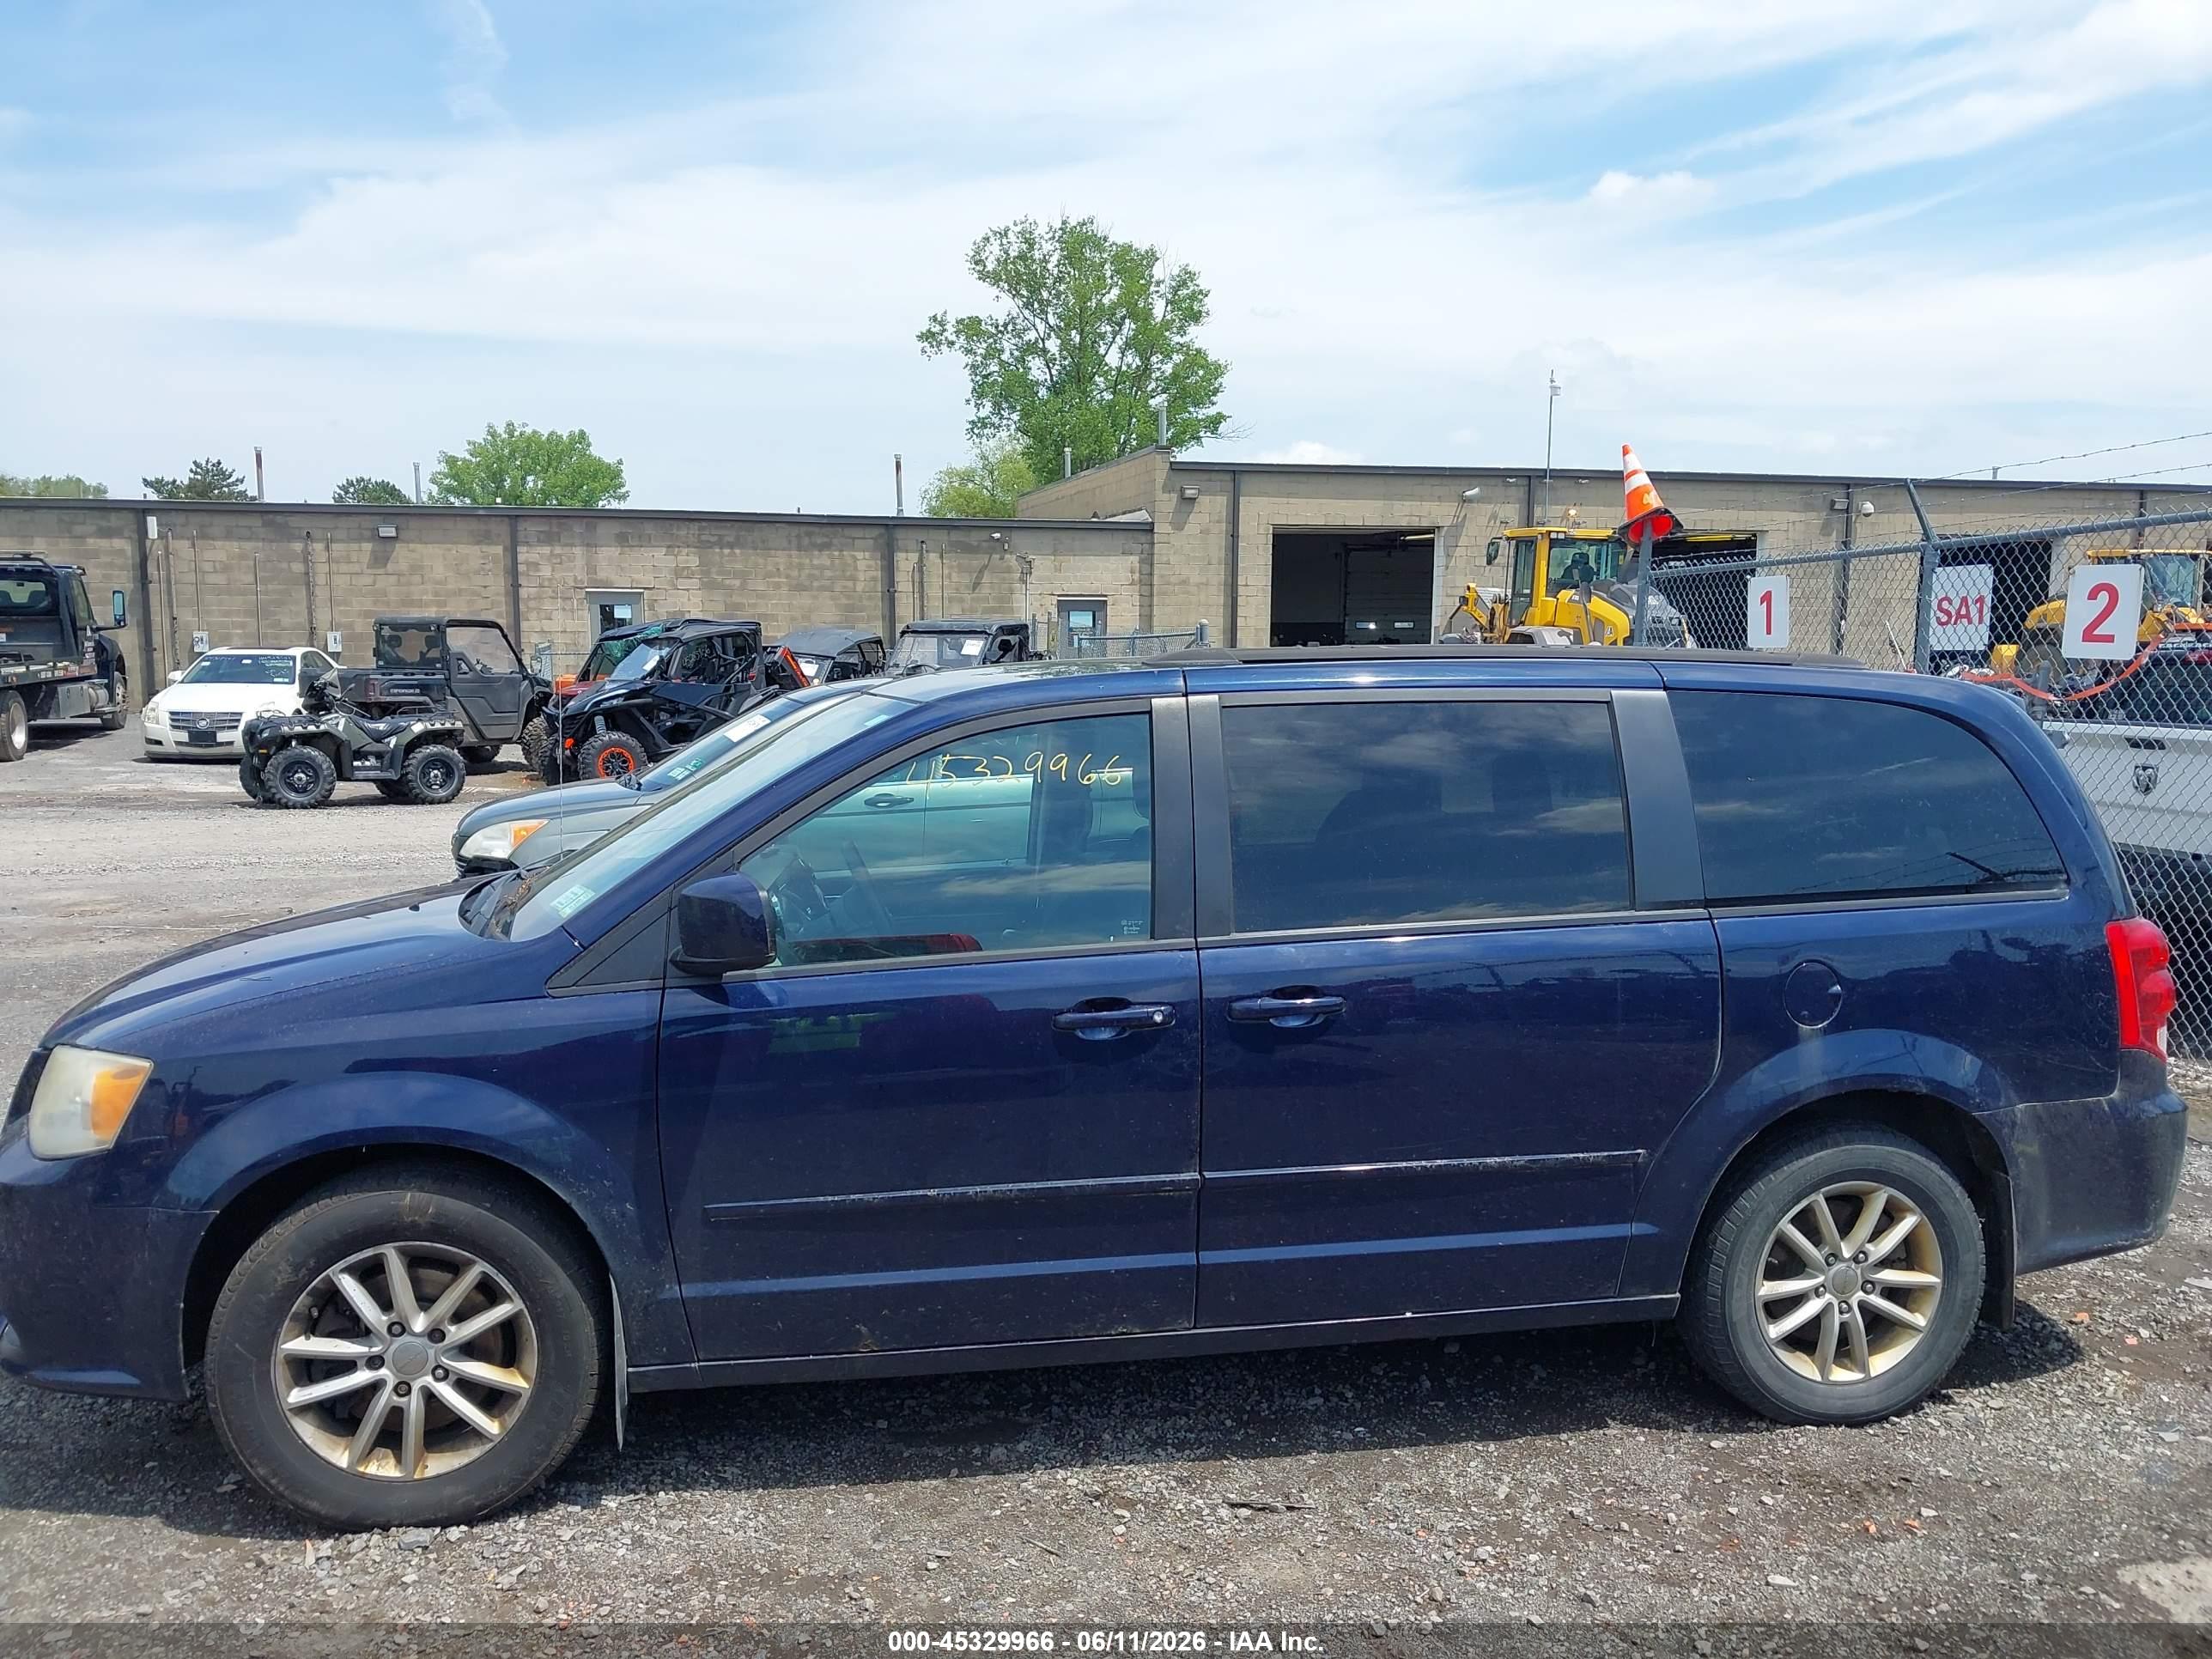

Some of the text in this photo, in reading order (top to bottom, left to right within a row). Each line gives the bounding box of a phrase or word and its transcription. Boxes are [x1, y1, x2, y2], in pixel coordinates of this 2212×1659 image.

[1759, 589, 1773, 635] 1
[1935, 594, 1985, 627] SA1
[2081, 581, 2120, 644] 2
[906, 750, 1122, 788] 45329966
